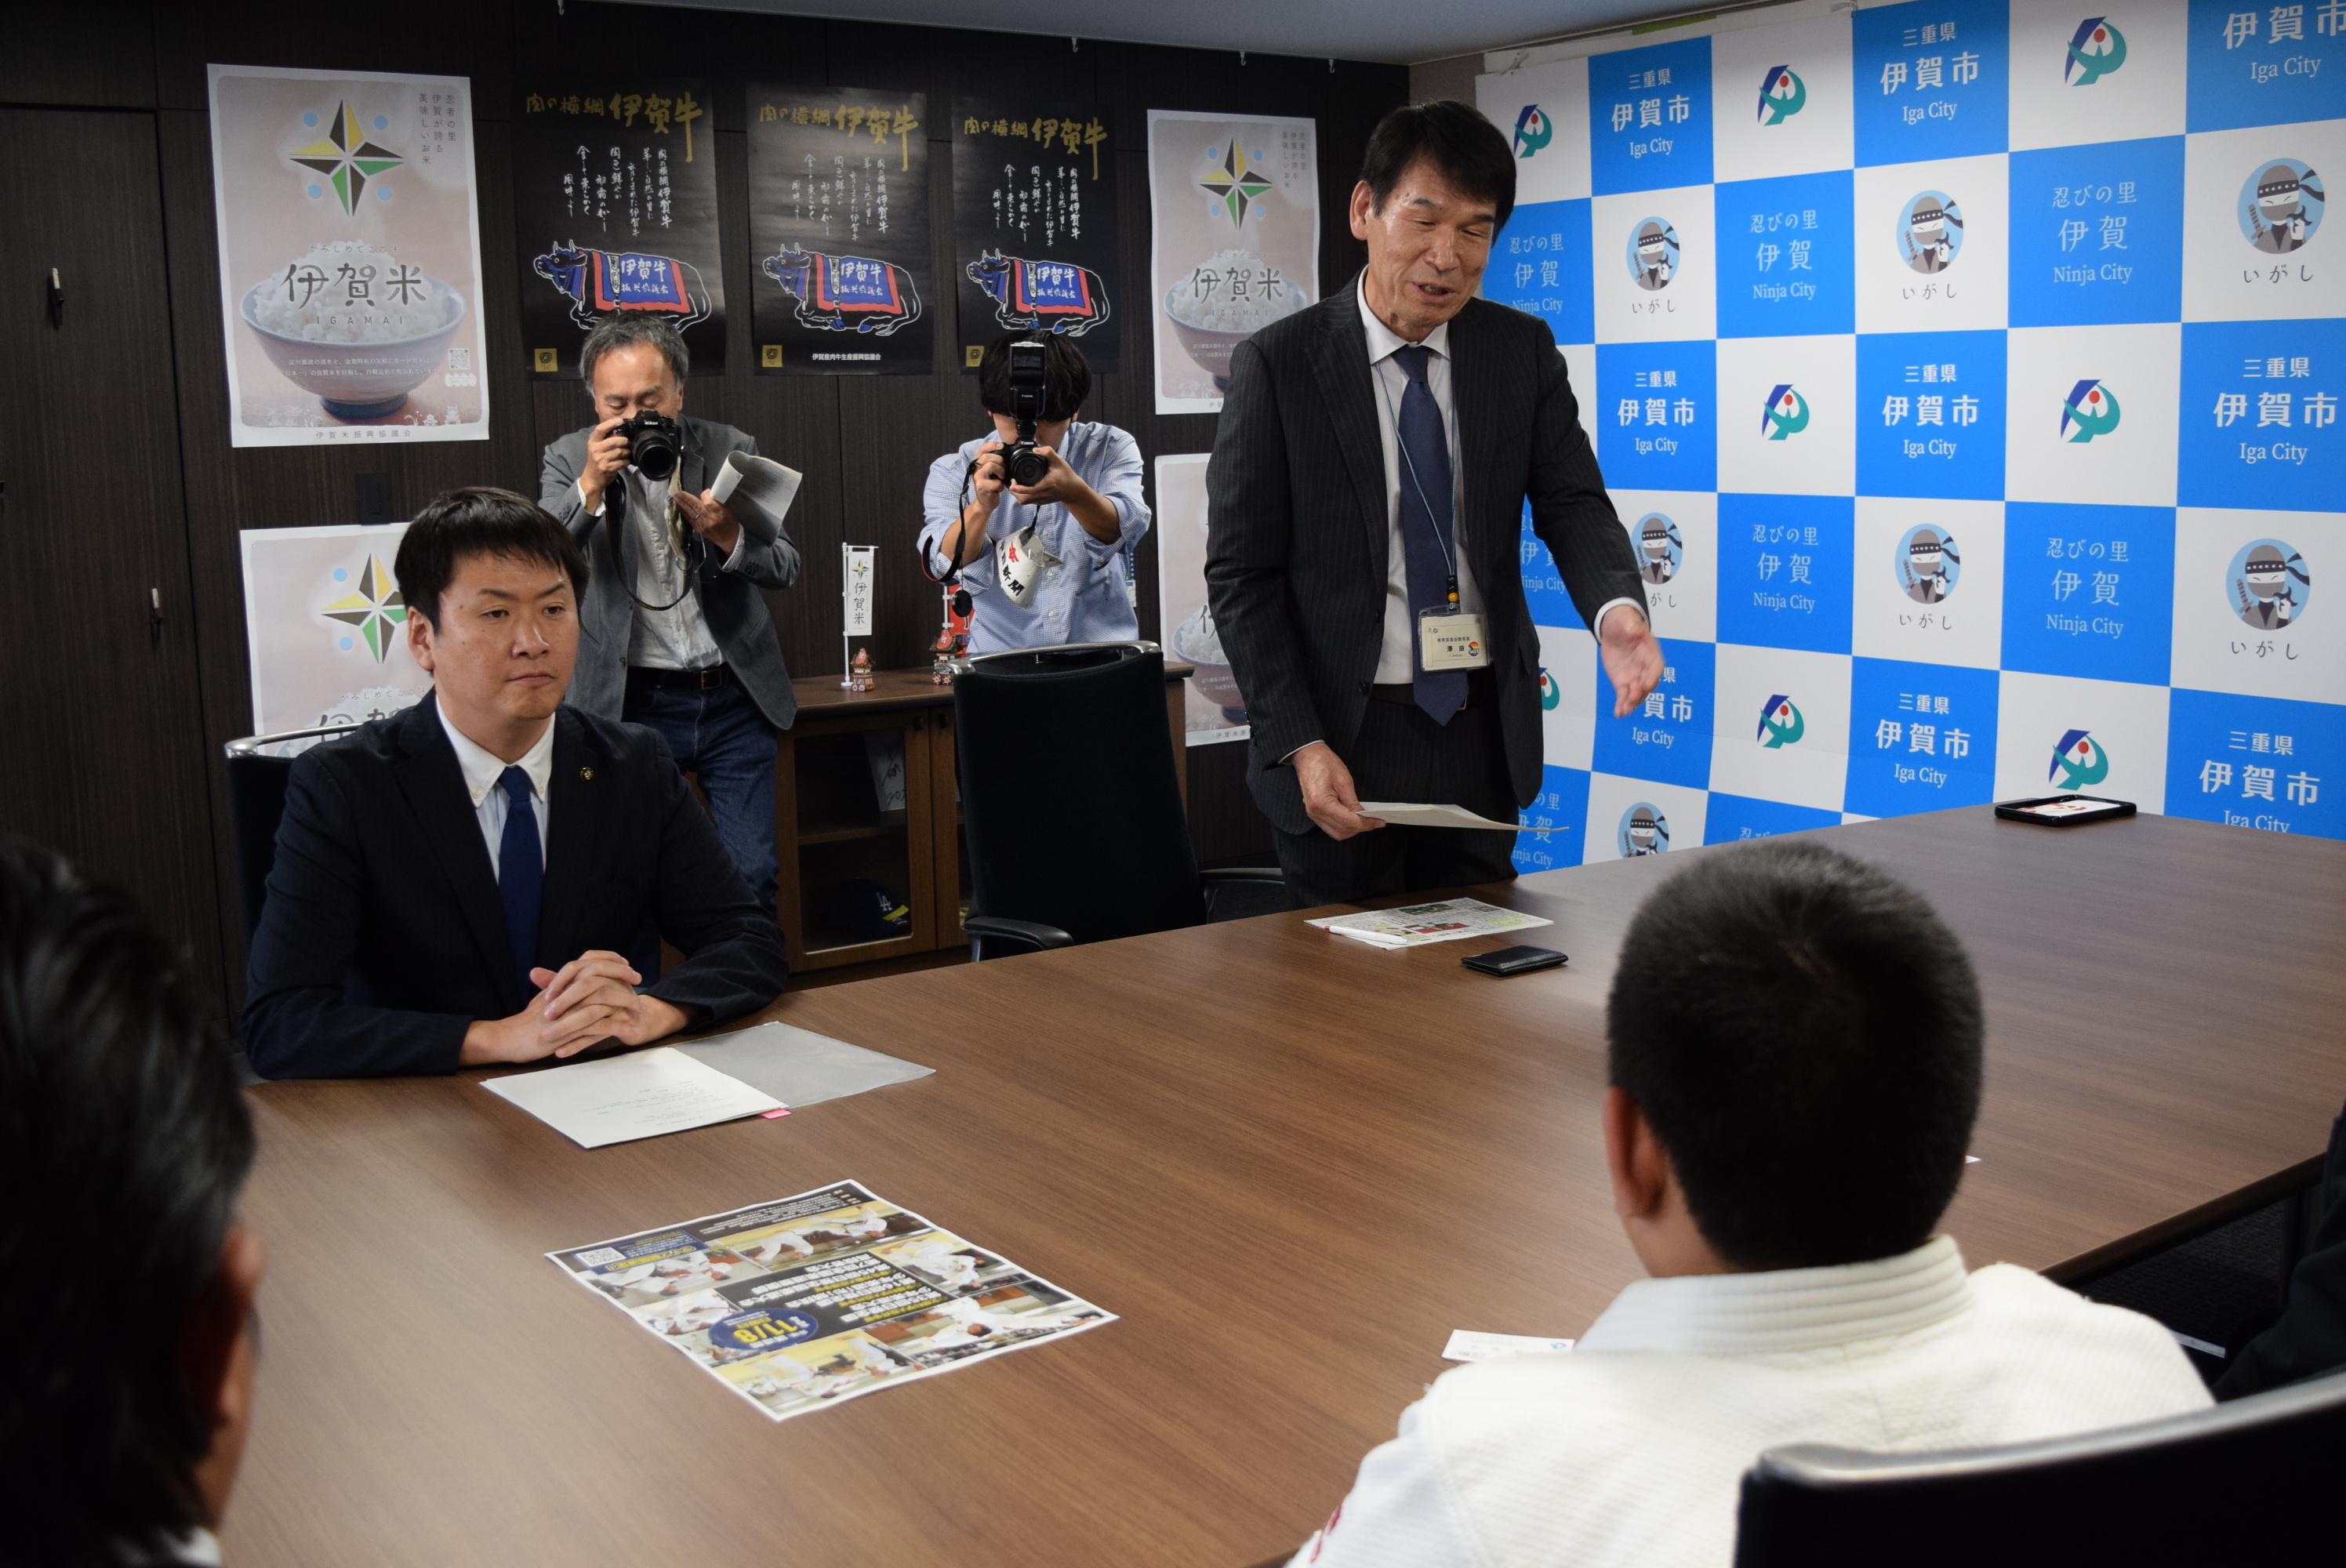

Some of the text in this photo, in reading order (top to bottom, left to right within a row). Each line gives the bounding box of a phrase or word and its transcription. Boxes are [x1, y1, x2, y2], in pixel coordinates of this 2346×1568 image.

[1903, 22, 1956, 46] 三重県
[1629, 68, 1671, 89] 三重県
[1880, 52, 1979, 95] 伊賀市
[2251, 56, 2321, 83] Iga City
[432, 94, 443, 152] 伊賀が誇る
[446, 95, 456, 141] 忍者の里
[1612, 95, 1689, 132] 伊賀市
[1903, 101, 1957, 125] Iga City
[419, 93, 431, 165] 美味しいお米
[609, 91, 703, 162] 伊賀牛
[835, 105, 919, 172] 伊賀牛
[1031, 117, 1108, 180] 伊賀牛
[1630, 138, 1672, 158] Iga City
[2053, 182, 2137, 208] 忍びの里
[1751, 210, 1818, 233] 忍びの里
[1510, 234, 1563, 253] 忍びの里
[2058, 216, 2127, 252] 伊賀
[1756, 240, 1811, 271] 伊賀
[621, 259, 666, 282] 伊賀牛
[841, 262, 882, 285] 伊賀牛
[1037, 267, 1074, 288] 伊賀牛
[1515, 260, 1559, 288] 伊賀
[2054, 263, 2132, 286] Ninja City
[2244, 264, 2313, 283] いがし
[280, 263, 426, 309] 伊賀米
[1189, 267, 1283, 304] 伊賀米
[1753, 282, 1816, 302] Ninja City
[1903, 284, 1956, 299] いがし
[1511, 297, 1563, 314] Ninja City
[1632, 299, 1675, 314] いがし
[317, 316, 402, 325] IGAMAI
[1636, 371, 1676, 387] 三重県
[1905, 365, 1956, 382] 三重県
[2243, 358, 2309, 377] 三重県
[1618, 398, 1694, 426] 伊賀市
[1883, 395, 1978, 426] 伊賀市
[2213, 392, 2337, 427] 伊賀市
[1636, 437, 1678, 455] Iga City
[1904, 439, 1956, 459] Iga City
[2240, 443, 2308, 465] Iga City
[1753, 525, 1818, 545] 忍びの里
[2046, 538, 2128, 561] 忍びの里
[1758, 553, 1811, 584] 伊賀
[1522, 575, 1565, 594] inja City
[2051, 570, 2119, 605] 伊賀
[854, 582, 867, 625] 伊賀米
[1651, 593, 1676, 608] がし
[1753, 593, 1815, 614] Ninja City
[1900, 614, 1951, 630] いがし
[2046, 615, 2123, 639] Ninja City
[2232, 641, 2297, 660] いがし
[1643, 692, 1693, 722] 賀市
[1899, 694, 1948, 714] 三重県
[1632, 728, 1674, 749] Iga City
[1876, 720, 1970, 758] 伊賀市
[2229, 731, 2293, 755] 三重県
[1894, 764, 1947, 788] Iga City
[2199, 760, 2319, 805] 伊賀市
[1534, 793, 1560, 811] の里
[2224, 811, 2290, 834] Iga City
[1513, 847, 1552, 869] inja City
[729, 1317, 801, 1344] 11/8
